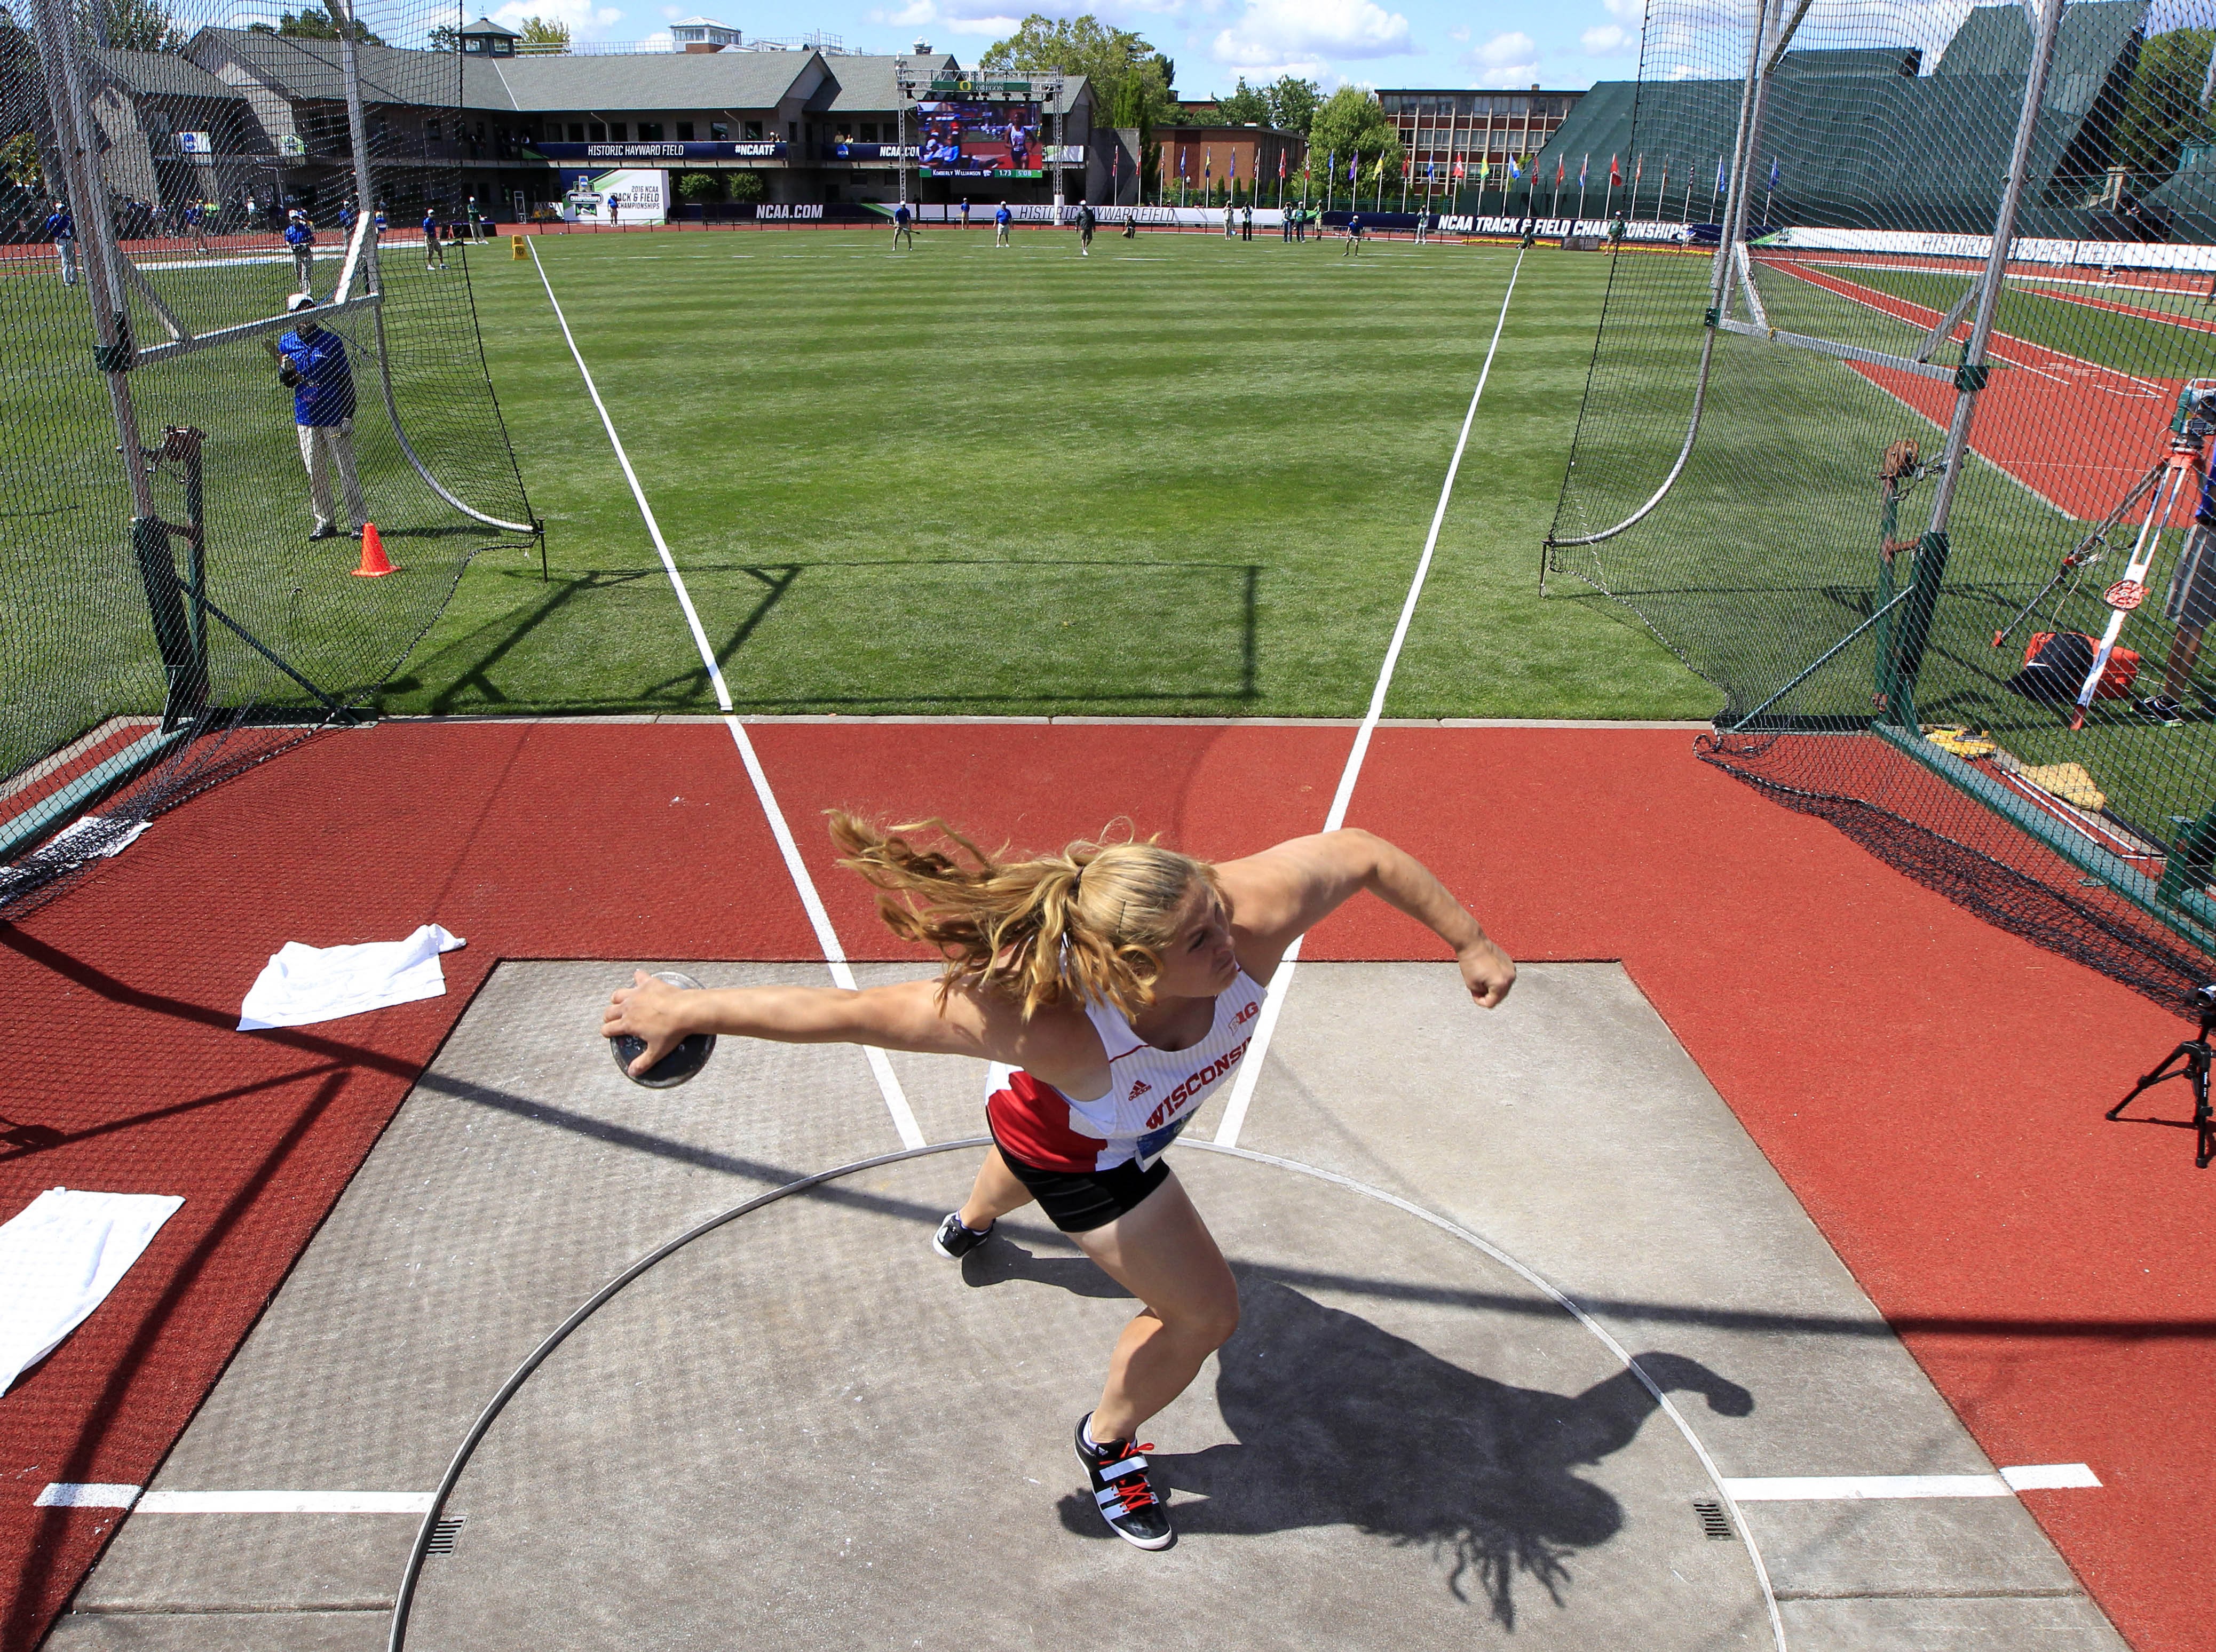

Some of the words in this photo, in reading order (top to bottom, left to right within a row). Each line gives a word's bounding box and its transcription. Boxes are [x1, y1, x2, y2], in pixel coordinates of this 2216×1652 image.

[588, 145, 623, 156] HISTORIC
[624, 145, 660, 156] HAYWARD
[662, 145, 684, 156] FIELD
[734, 144, 775, 156] #NCAATF
[634, 193, 638, 202] &
[640, 193, 659, 202] FIELD
[756, 204, 824, 219] NCAA.COM
[1020, 206, 1078, 220] HISTORIC
[1141, 208, 1175, 222] FIELD
[1437, 215, 1474, 231] NCAA
[1475, 217, 1521, 234] TRACK
[1521, 218, 1532, 233] &
[1533, 218, 1572, 237] FIELD
[1128, 1084, 1152, 1101] adidas
